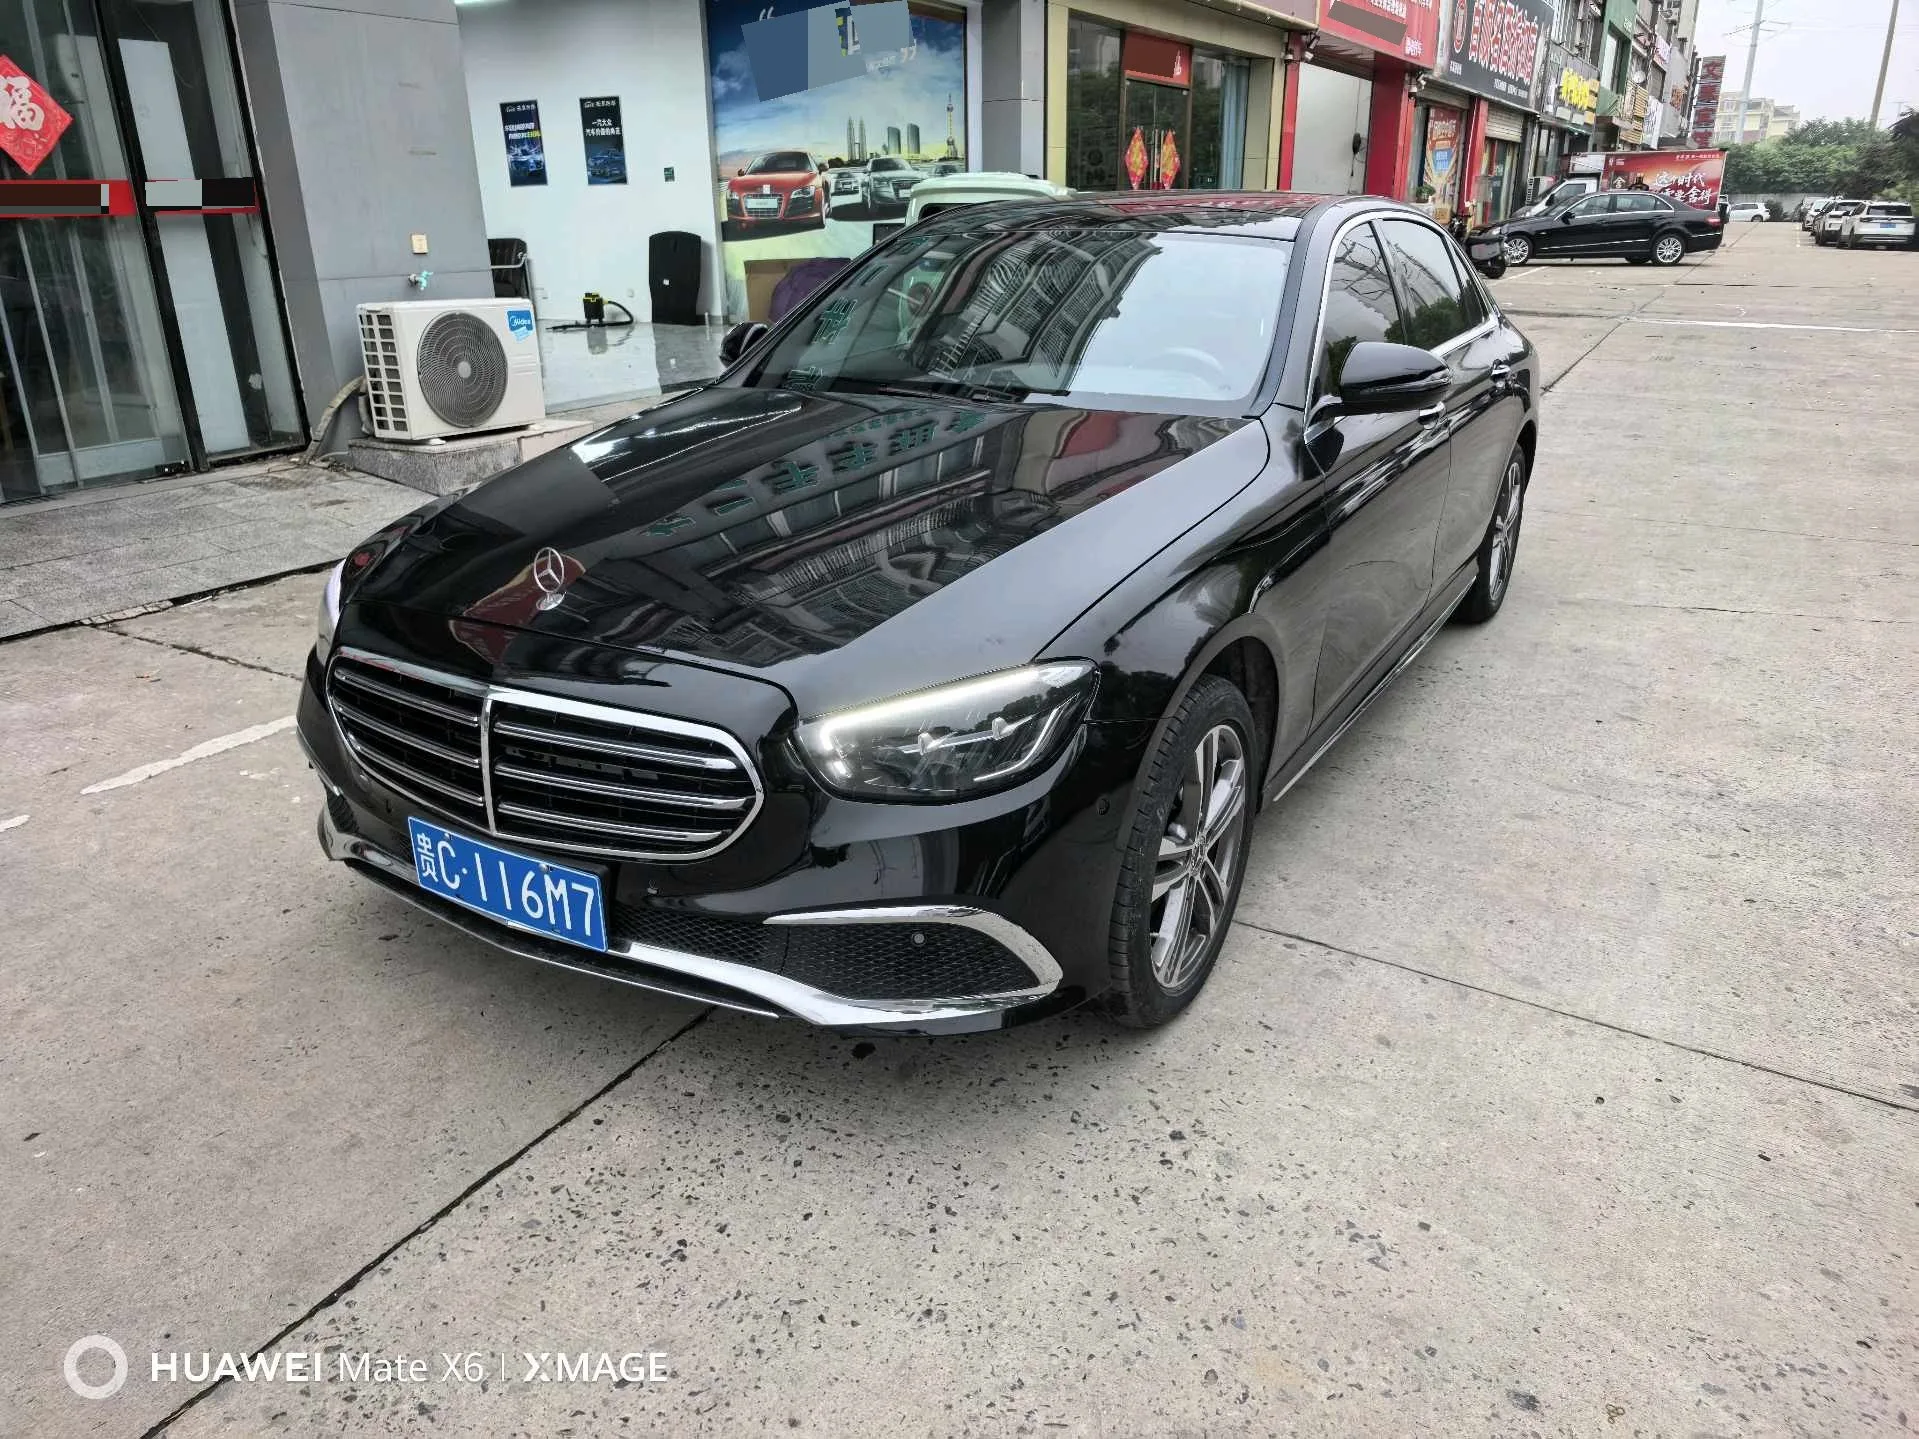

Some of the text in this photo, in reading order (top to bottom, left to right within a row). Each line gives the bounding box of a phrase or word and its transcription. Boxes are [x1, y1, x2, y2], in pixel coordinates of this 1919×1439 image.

[0, 76, 45, 131] 福
[1654, 170, 1706, 189] 这个时代
